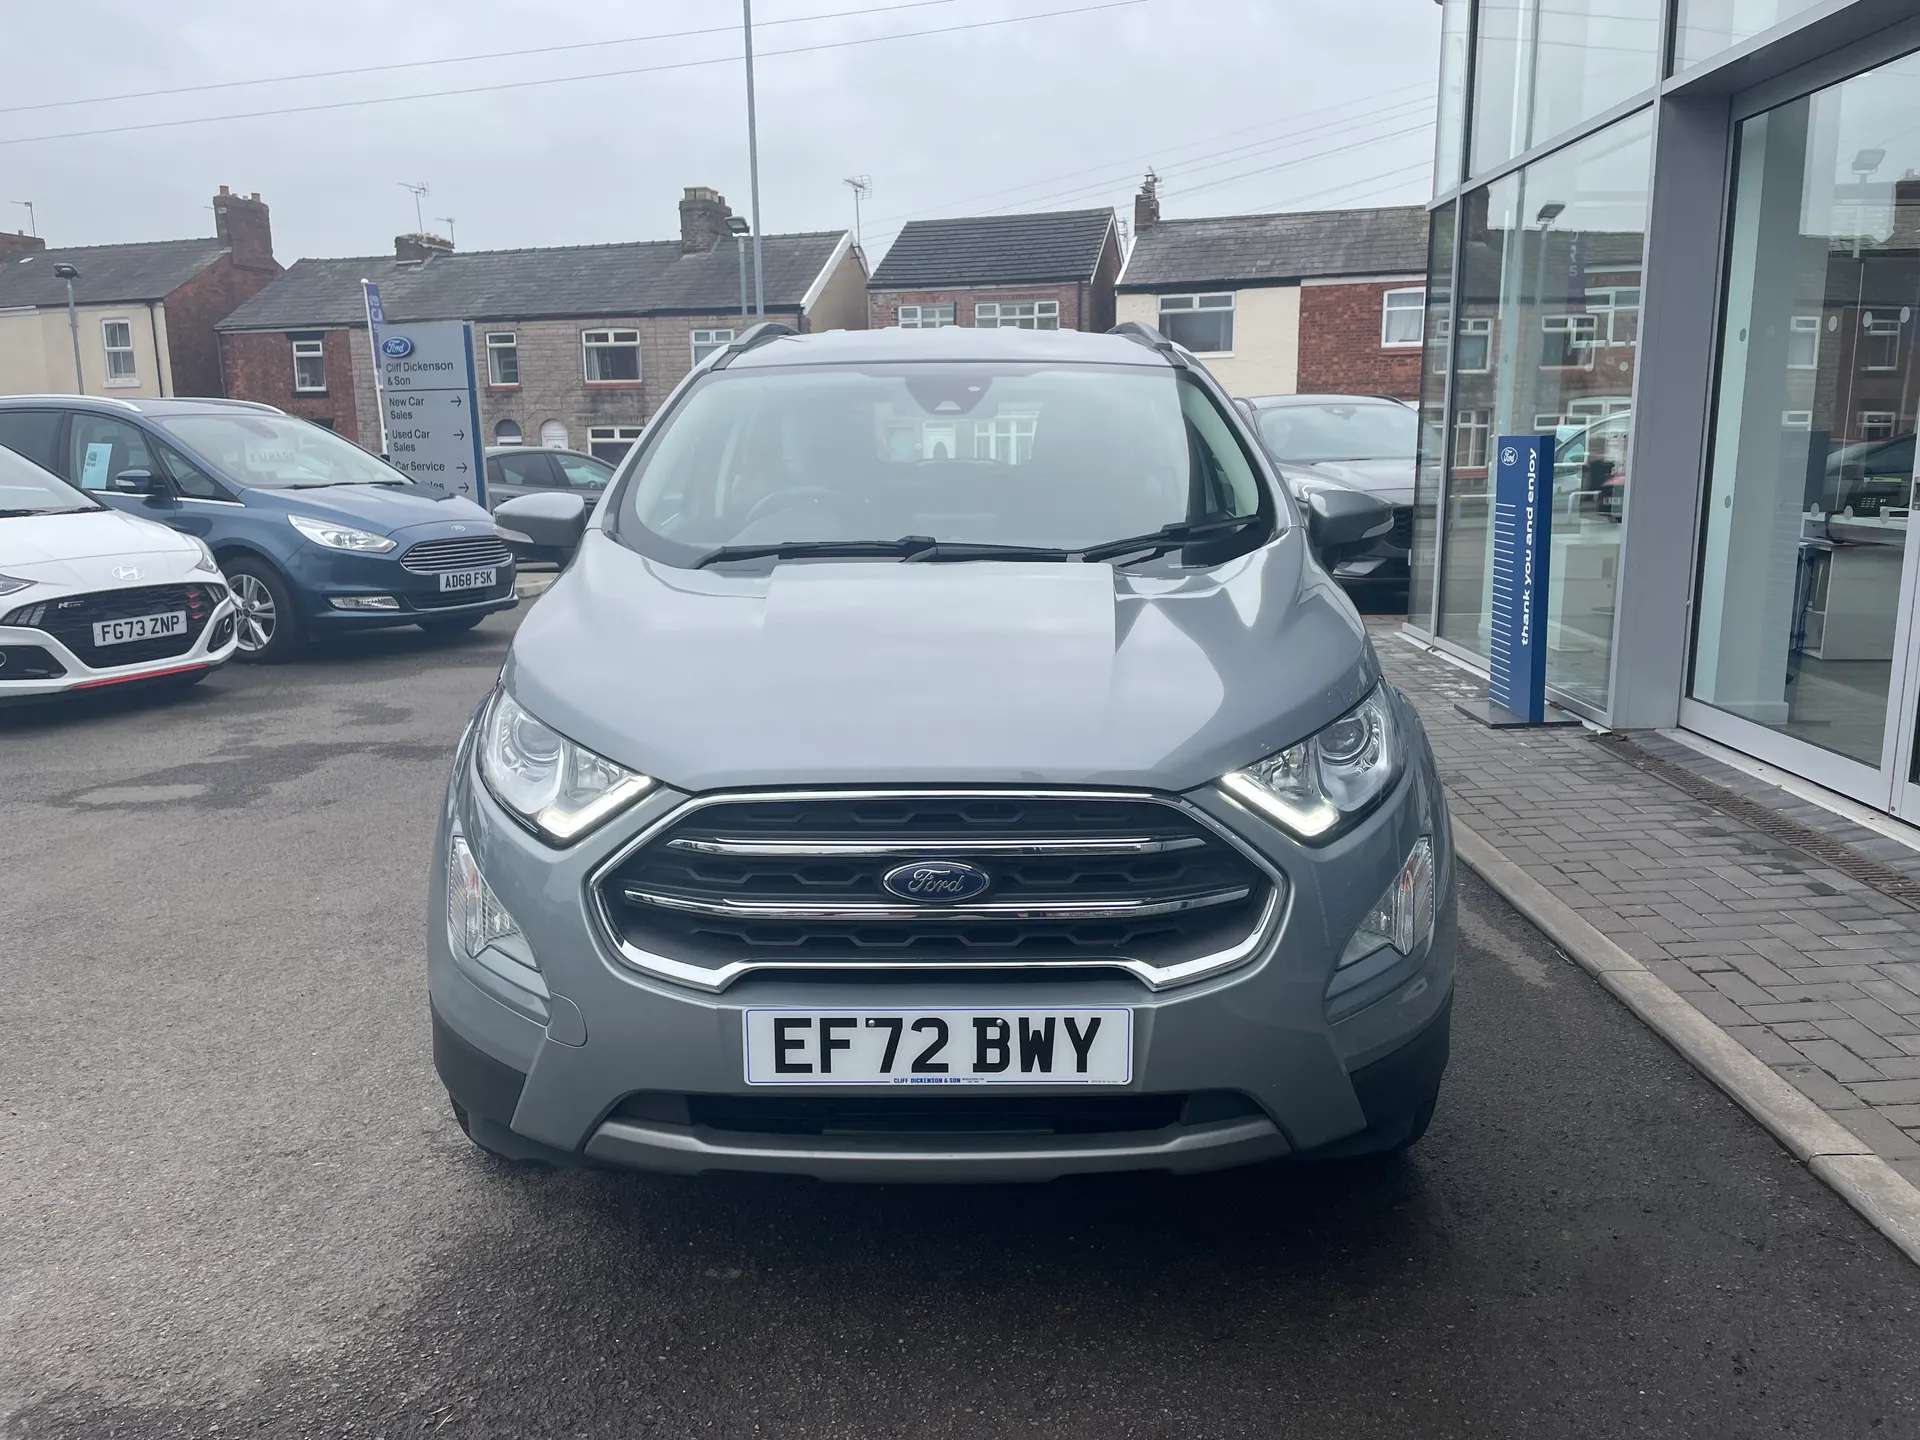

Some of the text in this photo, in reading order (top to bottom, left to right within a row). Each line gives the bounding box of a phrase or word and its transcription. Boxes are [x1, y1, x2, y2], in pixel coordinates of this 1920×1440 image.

[386, 361, 454, 373] Cliff Dickenson
[387, 376, 411, 386] & Son
[389, 396, 425, 407] New Car
[390, 410, 413, 420] Sales
[392, 429, 430, 440] Used Car
[393, 442, 416, 452] Sales
[411, 461, 446, 472] Service
[1521, 447, 1537, 646] thank you and enjoy
[445, 570, 493, 589] AD68 FSK
[101, 615, 180, 642] FG73 ZNP
[908, 868, 965, 892] Ford
[773, 1016, 1102, 1074] EF72 BWY
